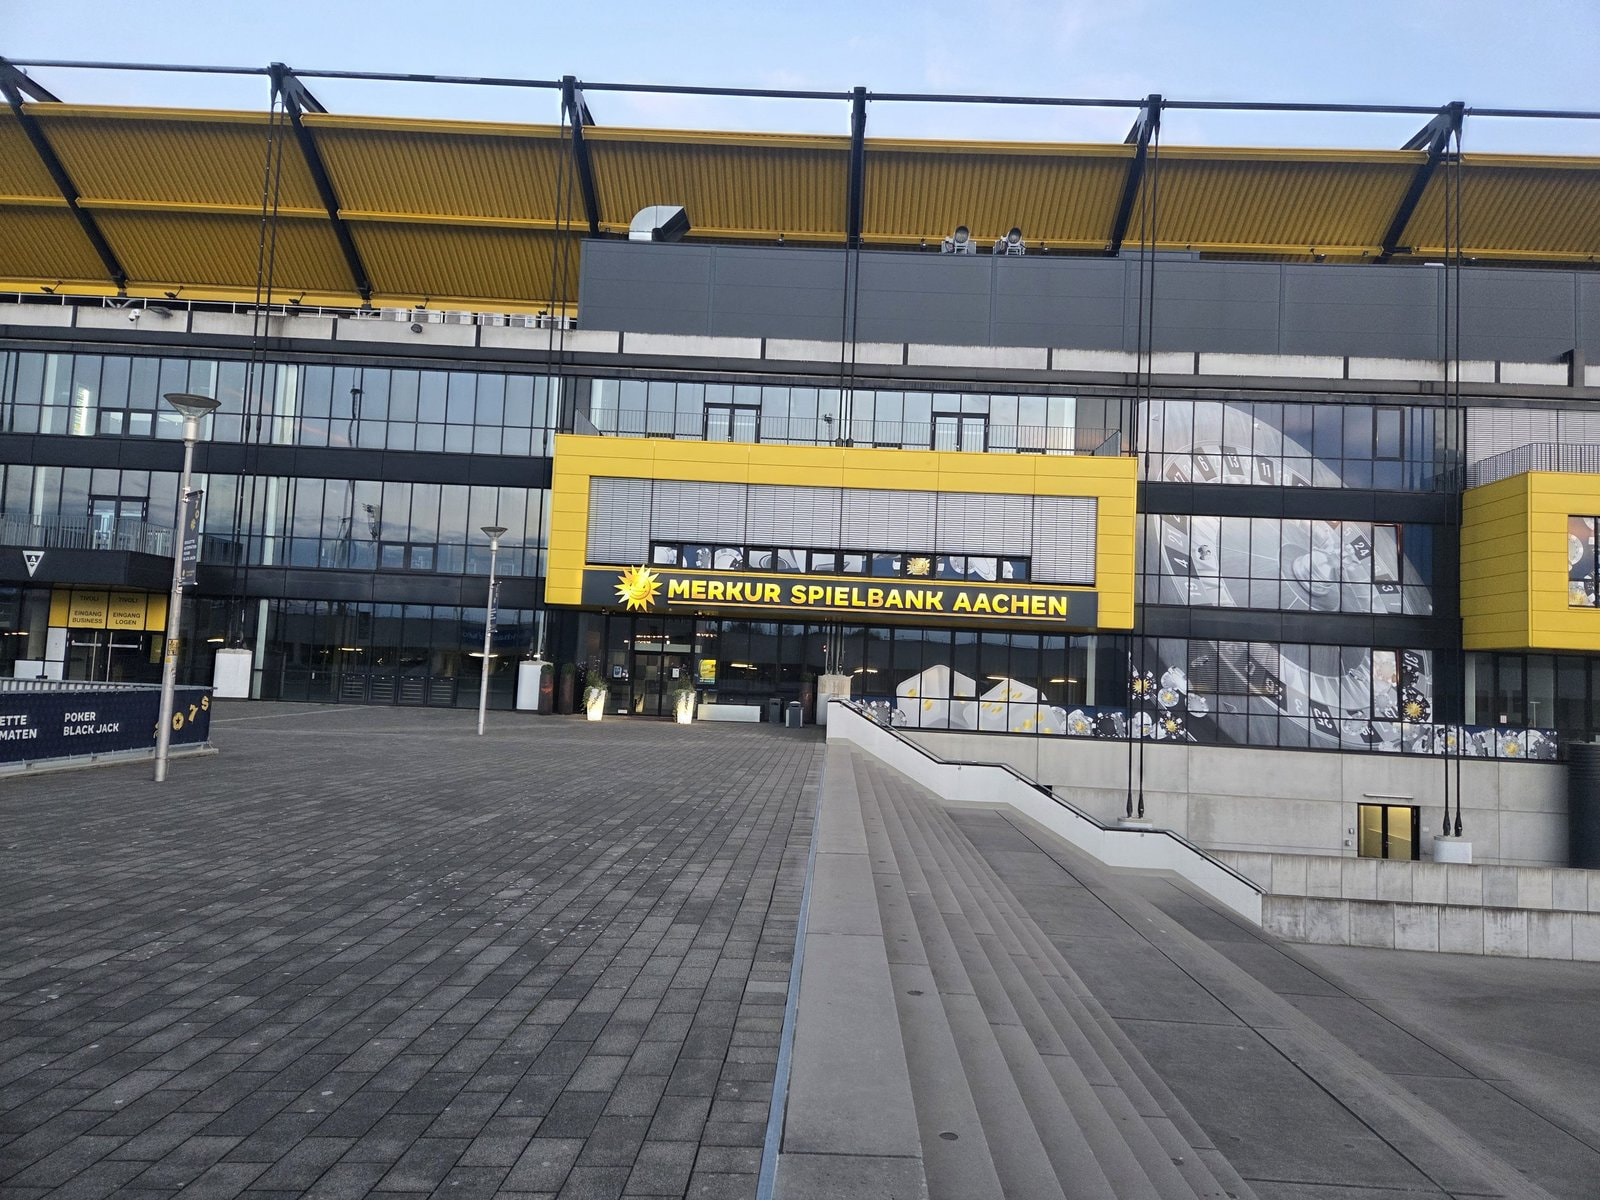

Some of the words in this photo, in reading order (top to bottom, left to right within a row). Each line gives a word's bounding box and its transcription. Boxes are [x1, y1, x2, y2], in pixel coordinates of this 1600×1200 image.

[1197, 455, 1210, 472] 6
[1354, 541, 1370, 557] 24
[667, 578, 781, 604] MERKUR
[790, 584, 944, 612] SPIELBANK
[952, 592, 1067, 617] AACHEN
[64, 711, 96, 722] POKER
[63, 724, 94, 736] BLACK
[96, 722, 120, 734] JACK
